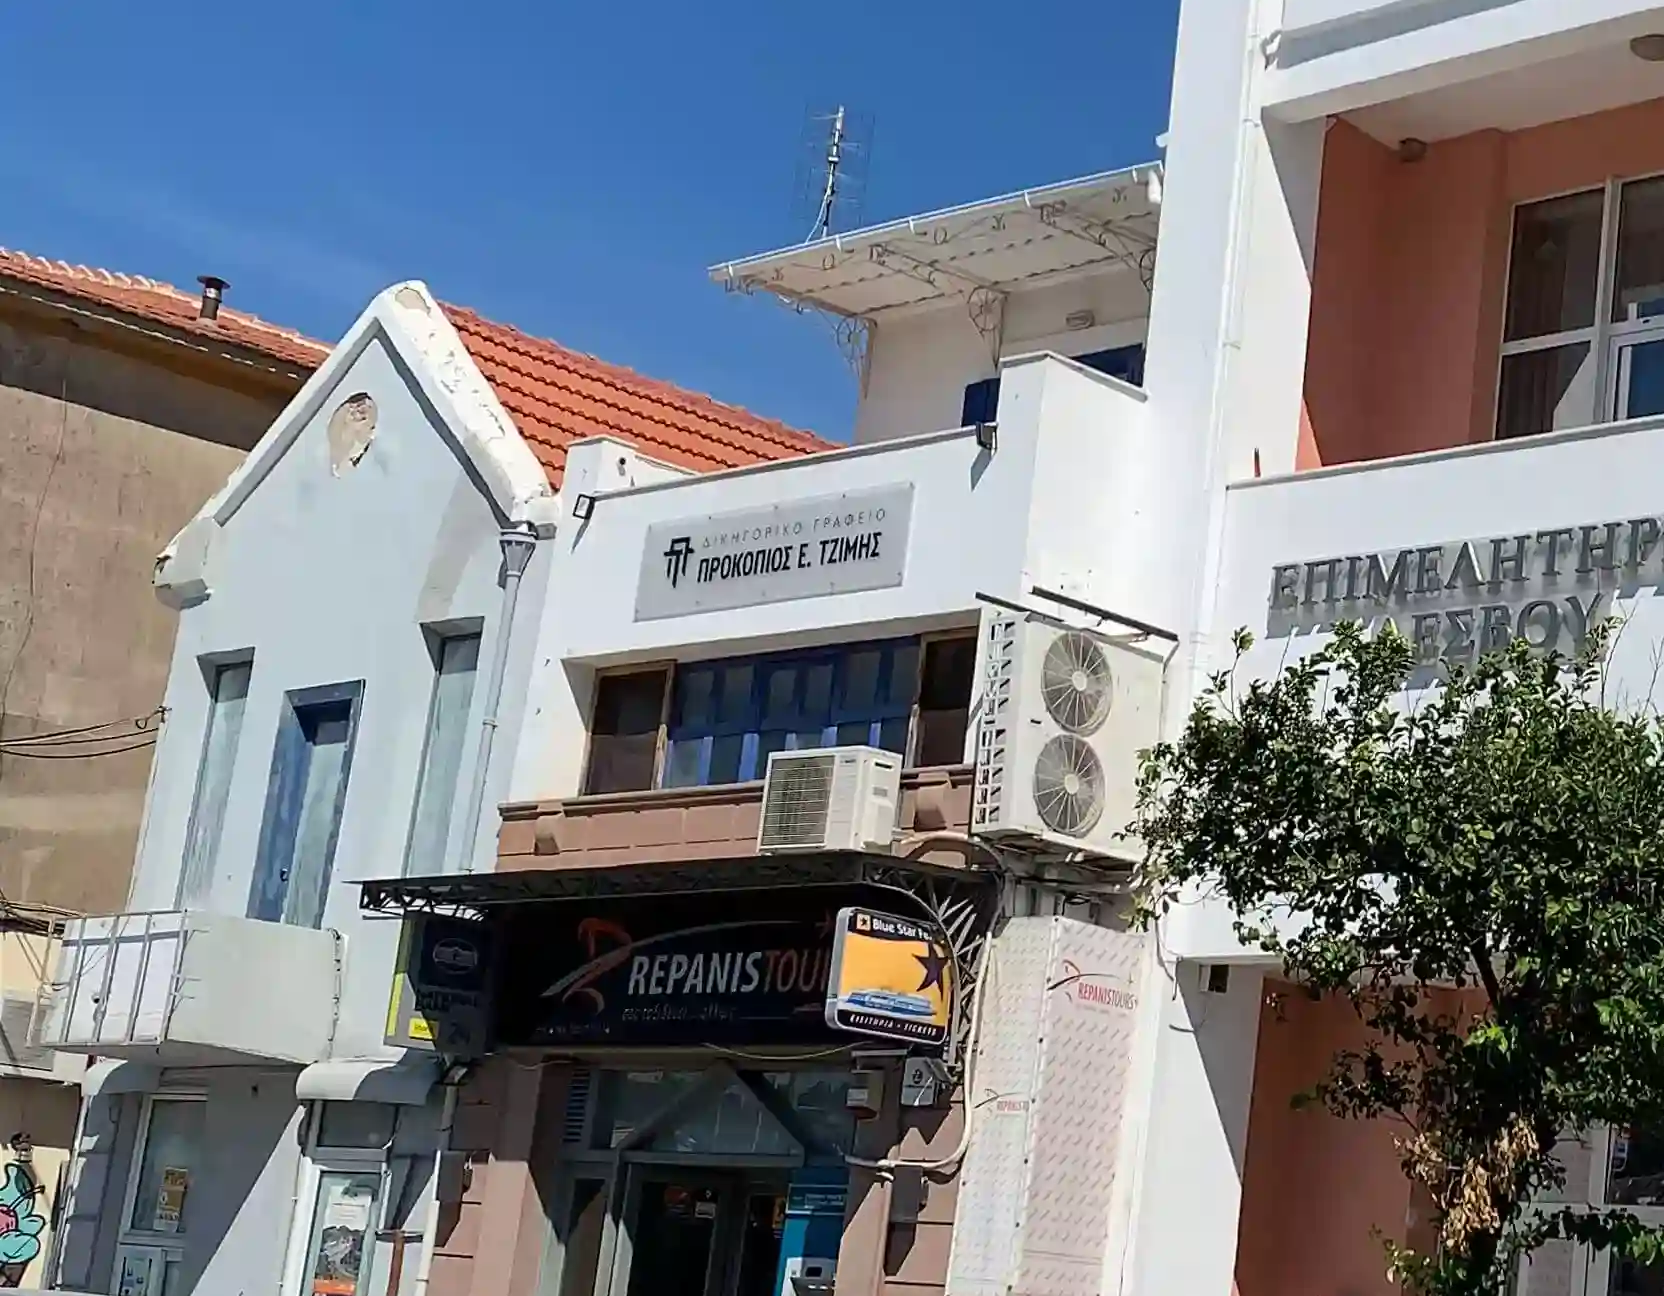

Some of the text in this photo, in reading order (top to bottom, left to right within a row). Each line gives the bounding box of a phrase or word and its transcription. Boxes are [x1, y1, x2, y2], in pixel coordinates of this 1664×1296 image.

[702, 507, 887, 549] ΔΙΚΗΓΟΡΙΚΟ ΓΡΑΦΕΙΟ
[697, 545, 793, 584] ΠΡΟΚΟΠΙΟΣ
[819, 531, 882, 566] ΤΖΙΜΗΣ
[1380, 592, 1605, 661] ΕΣΒΟΥ
[872, 918, 895, 933] Blue
[897, 923, 916, 937] Star
